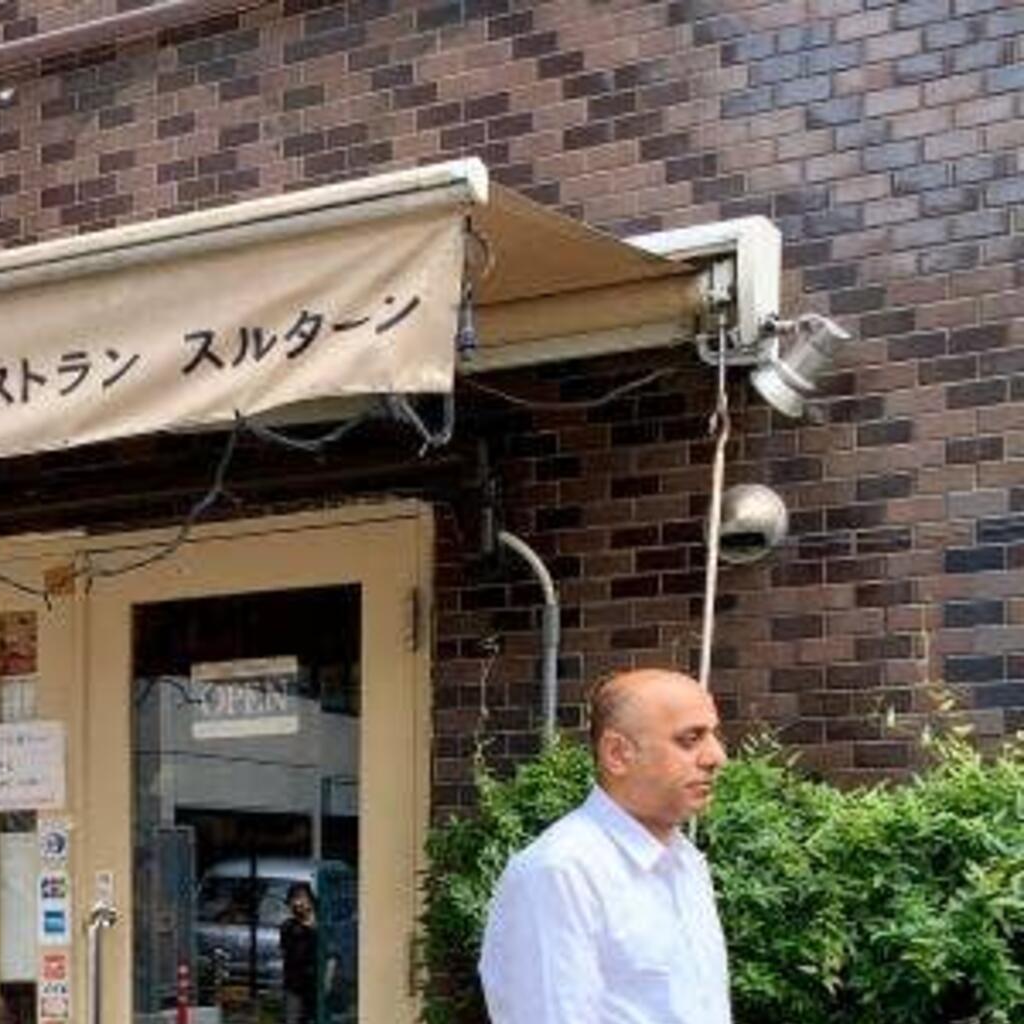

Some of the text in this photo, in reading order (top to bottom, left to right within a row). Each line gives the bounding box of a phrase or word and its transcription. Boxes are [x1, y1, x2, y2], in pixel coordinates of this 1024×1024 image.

[182, 296, 421, 375] スルターン
